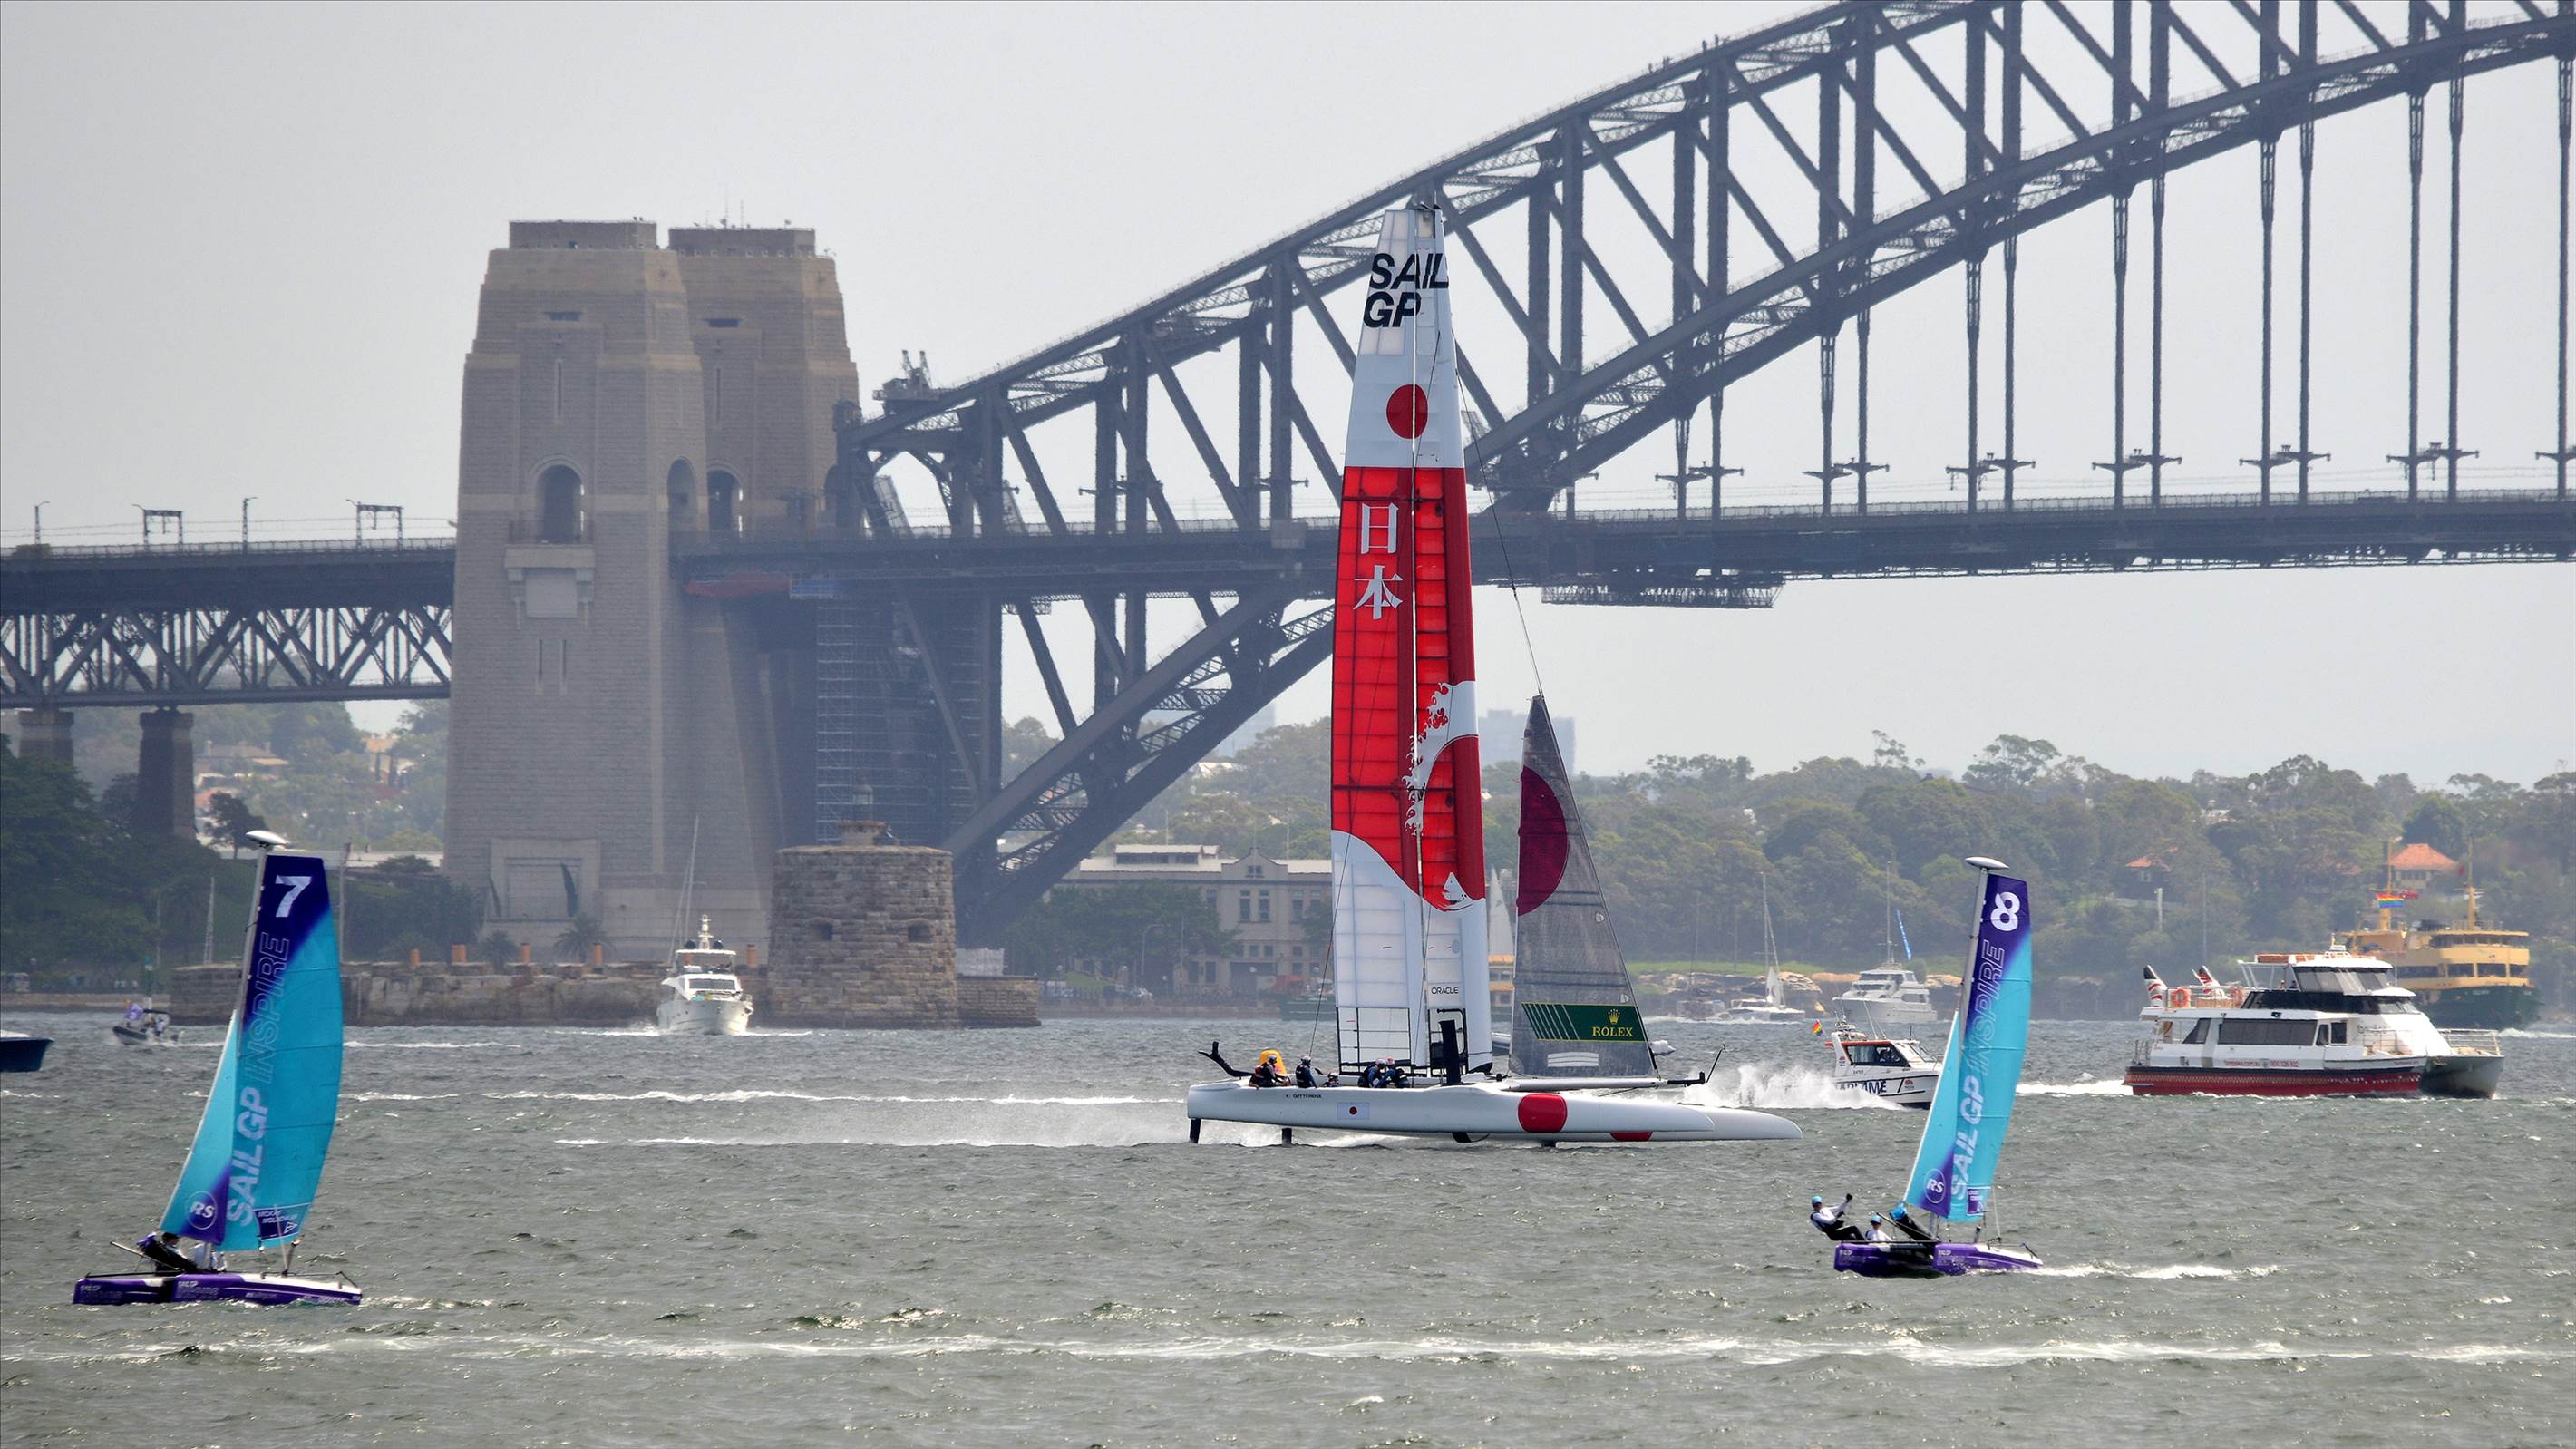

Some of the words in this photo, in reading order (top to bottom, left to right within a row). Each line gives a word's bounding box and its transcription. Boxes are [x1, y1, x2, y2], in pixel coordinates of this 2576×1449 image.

[1369, 253, 1449, 289] SAIL
[1363, 291, 1422, 327] GP
[1353, 502, 1403, 619] 日本
[275, 874, 312, 918] 7
[1990, 891, 2021, 932] 8
[244, 931, 290, 1084] INSPIRE
[1431, 987, 1459, 995] ORACLE
[1965, 939, 2006, 1077] INSPIRE
[1592, 1026, 1633, 1037] ROLEX
[1926, 1178, 1945, 1193] RS
[189, 1201, 215, 1218] RS
